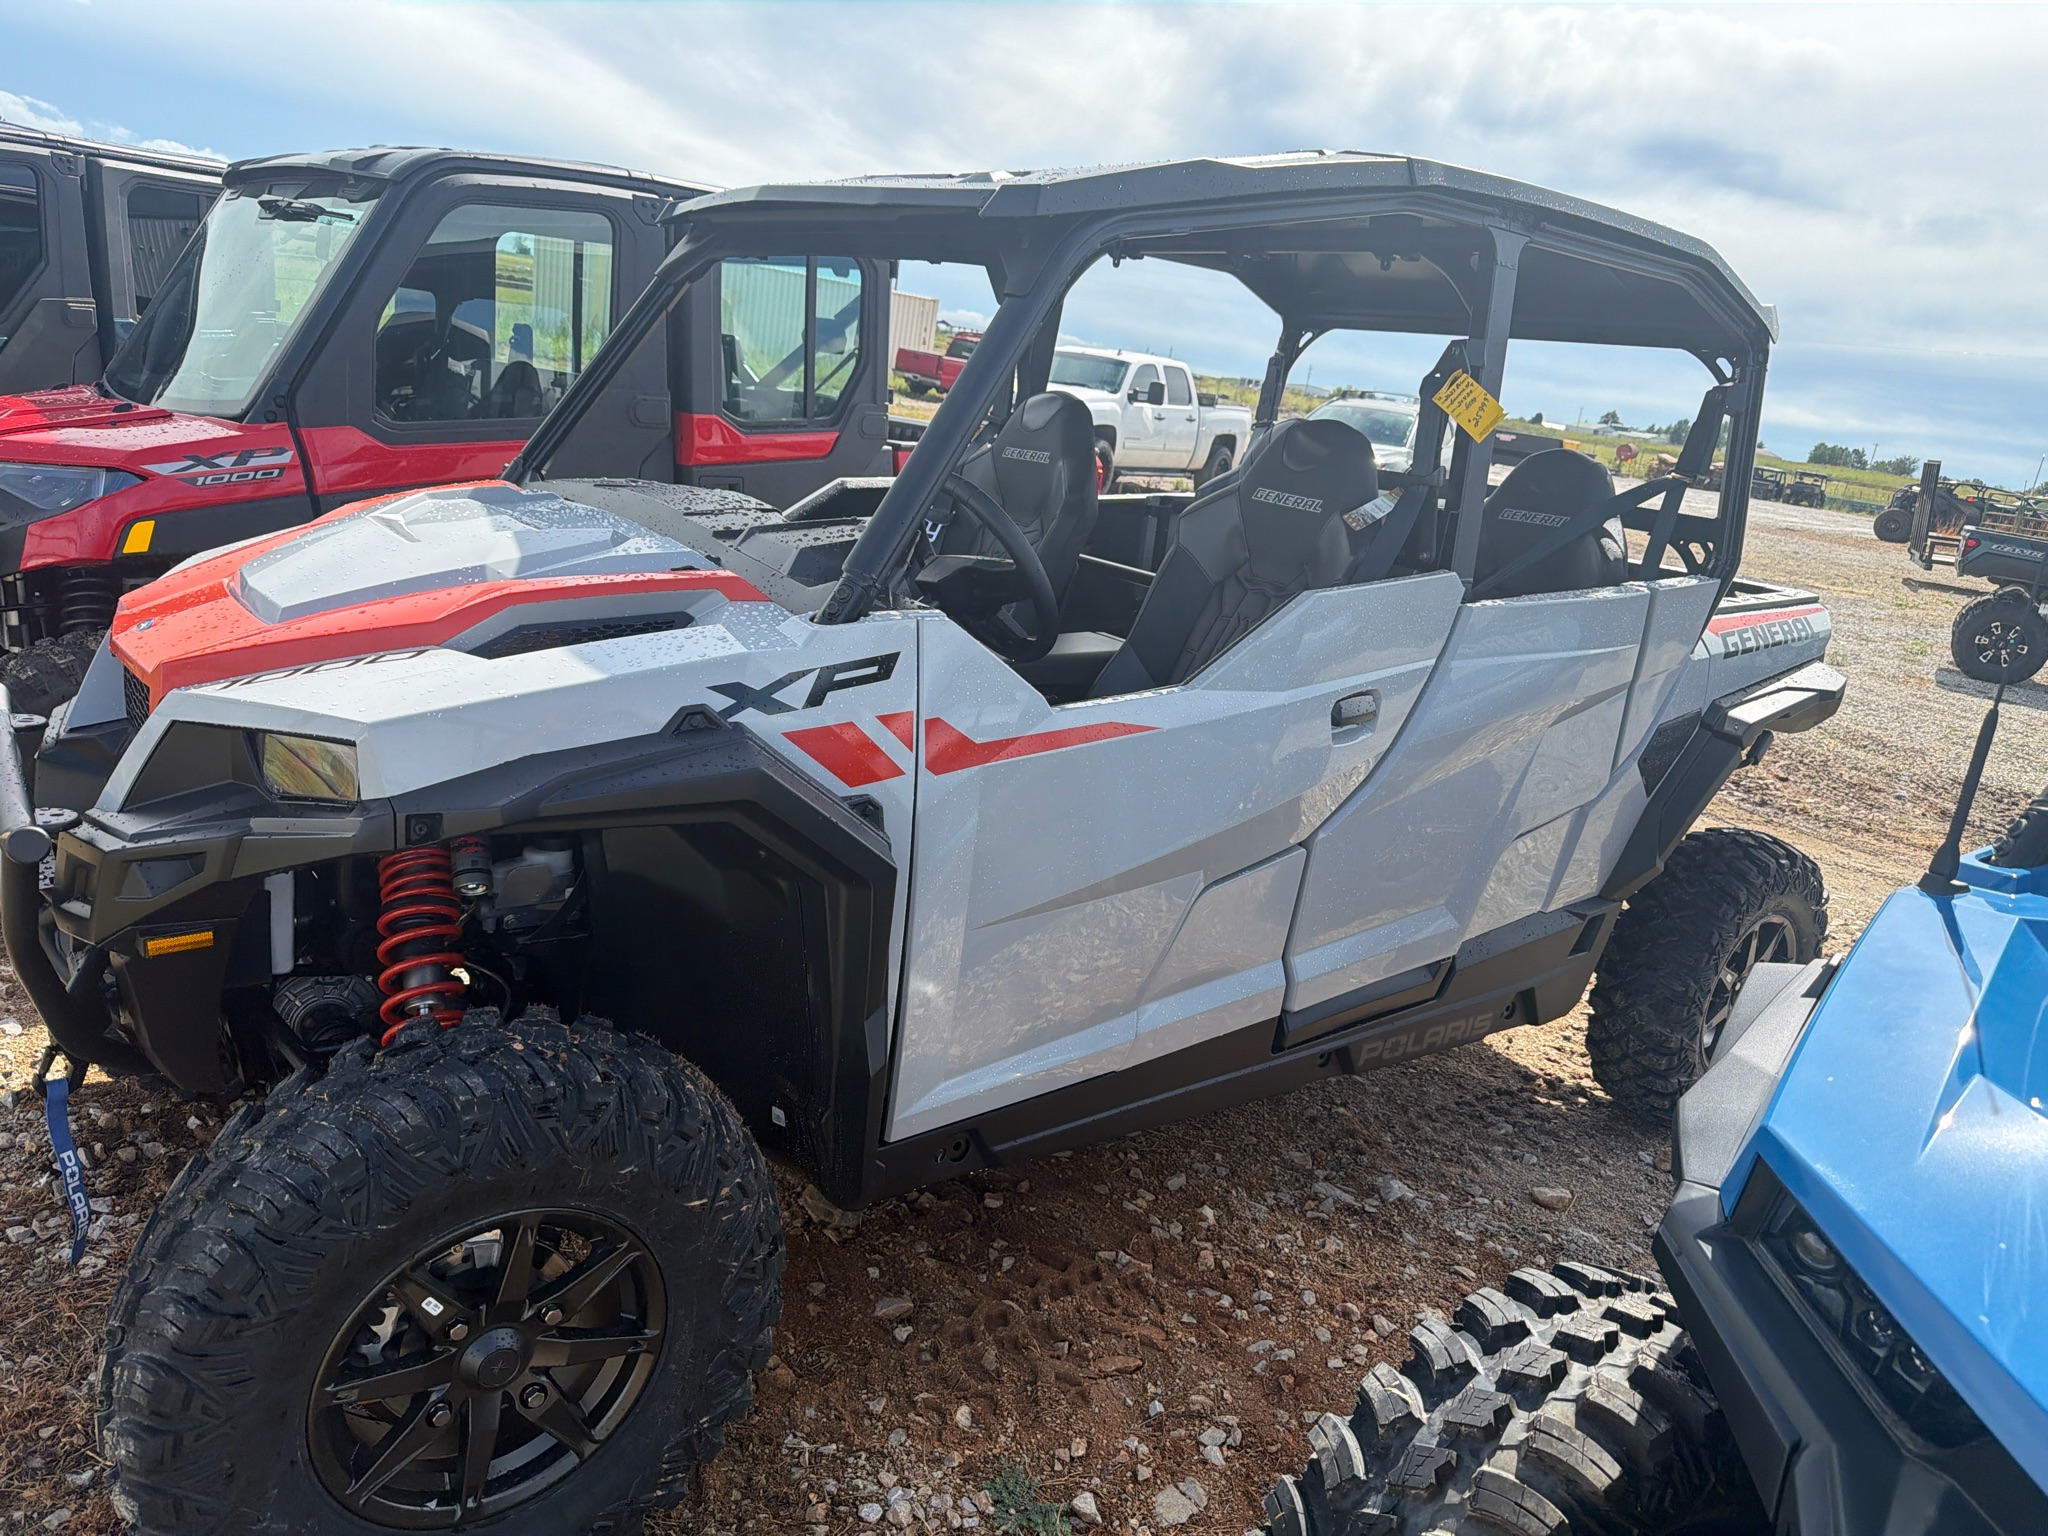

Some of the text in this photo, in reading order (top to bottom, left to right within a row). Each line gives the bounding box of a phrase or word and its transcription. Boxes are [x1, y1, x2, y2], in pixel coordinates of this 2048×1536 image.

[167, 446, 290, 474] XP
[1002, 446, 1051, 464] GENERAL
[196, 468, 280, 486] 1000
[1252, 487, 1323, 513] GENERAL
[1719, 616, 1823, 660] GENERAL
[705, 651, 901, 721] XP
[1358, 1012, 1494, 1067] POLARIS
[59, 1149, 90, 1241] POLARIS
